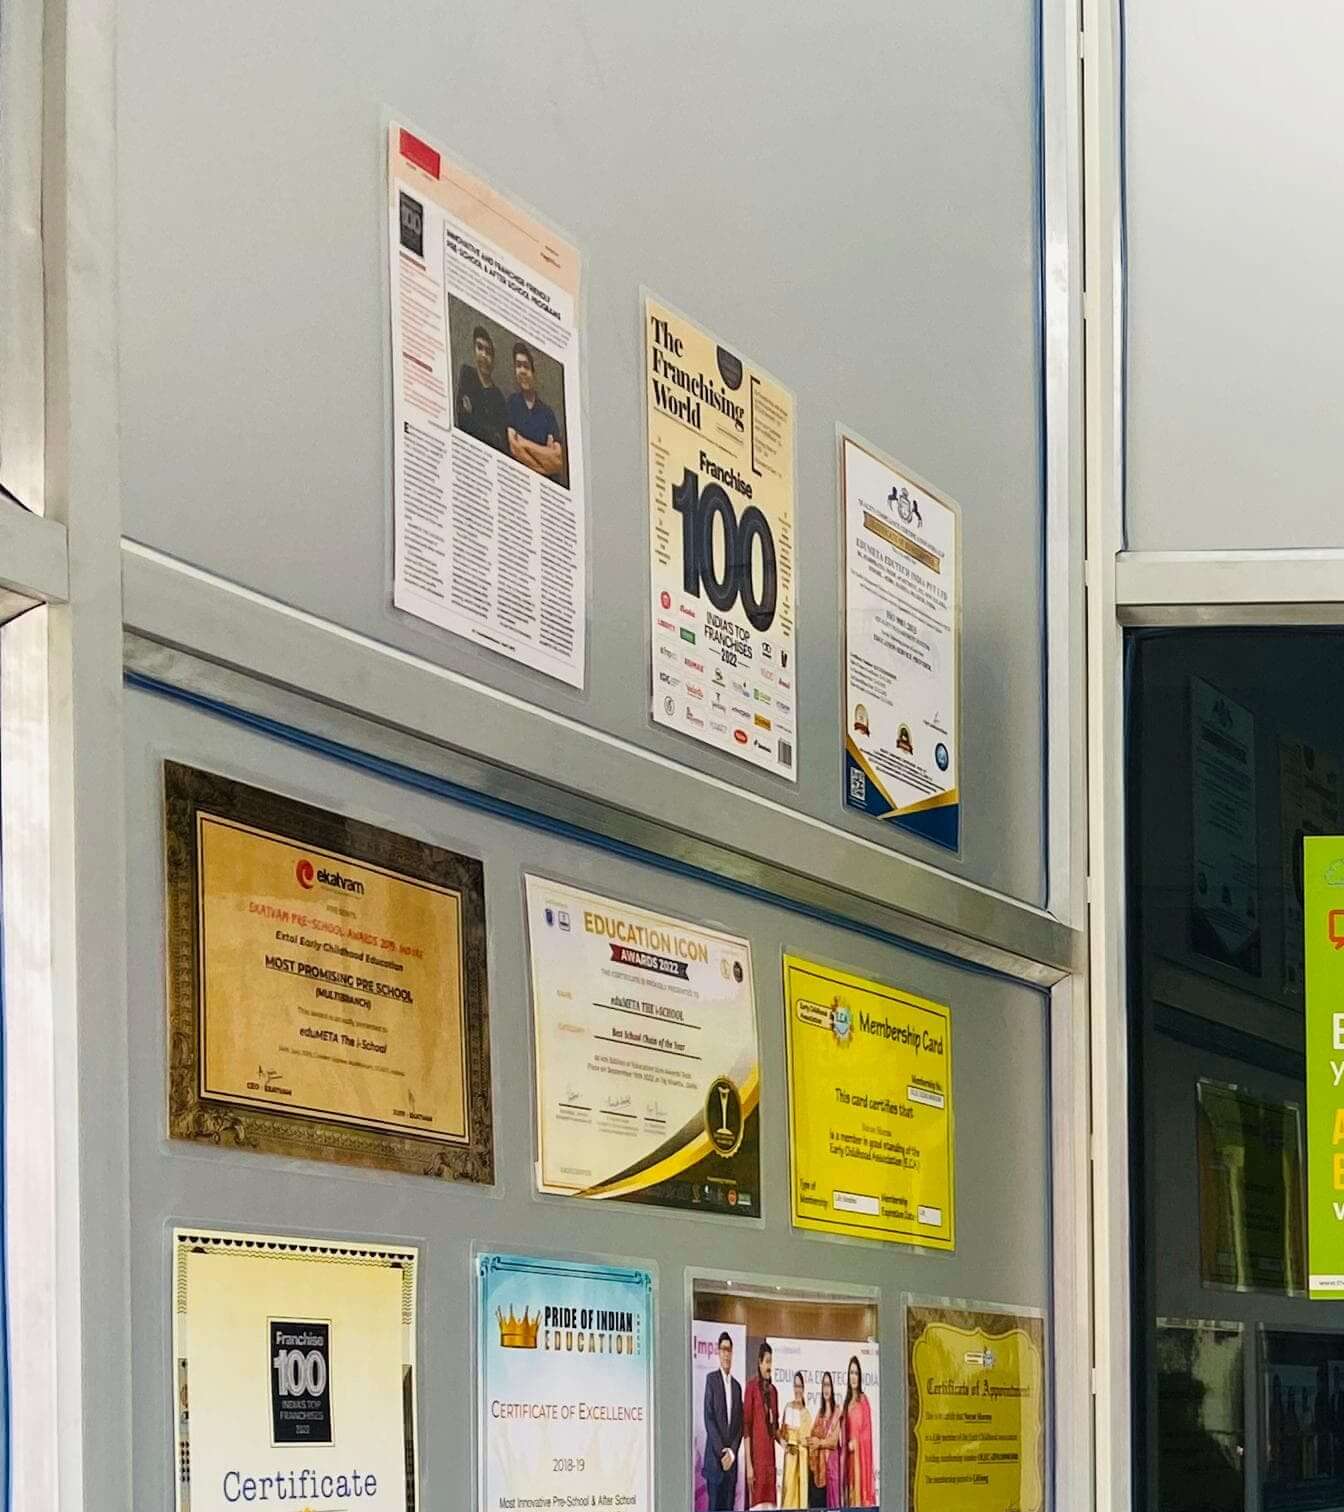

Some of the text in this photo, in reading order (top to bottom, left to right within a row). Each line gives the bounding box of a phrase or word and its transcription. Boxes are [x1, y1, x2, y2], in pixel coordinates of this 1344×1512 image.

[651, 316, 683, 358] The
[652, 347, 745, 433] Franchising
[652, 379, 701, 430] World
[699, 450, 753, 500] Franchise
[672, 467, 777, 632] 100
[316, 869, 365, 896] ekatvam
[584, 910, 708, 965] EDUCATION ICON
[620, 951, 679, 974] AWARDS 2022
[265, 954, 413, 1004] MOST PROMISING PRE SCHOOL
[859, 1010, 944, 1056] Membership Card
[835, 1088, 868, 1108] This card
[544, 1306, 633, 1332] PRIDE OF INDIAN
[275, 1330, 324, 1346] Franchise
[544, 1330, 633, 1355] EDUCATION
[273, 1349, 327, 1397] 100
[927, 1379, 968, 1398] Certificate
[491, 1400, 643, 1421] CERTIFICATE OF EXCELLENCE
[552, 1458, 585, 1472] 2018-19
[223, 1470, 377, 1502] Certificate
[499, 1494, 636, 1509] Most Innovative After School
